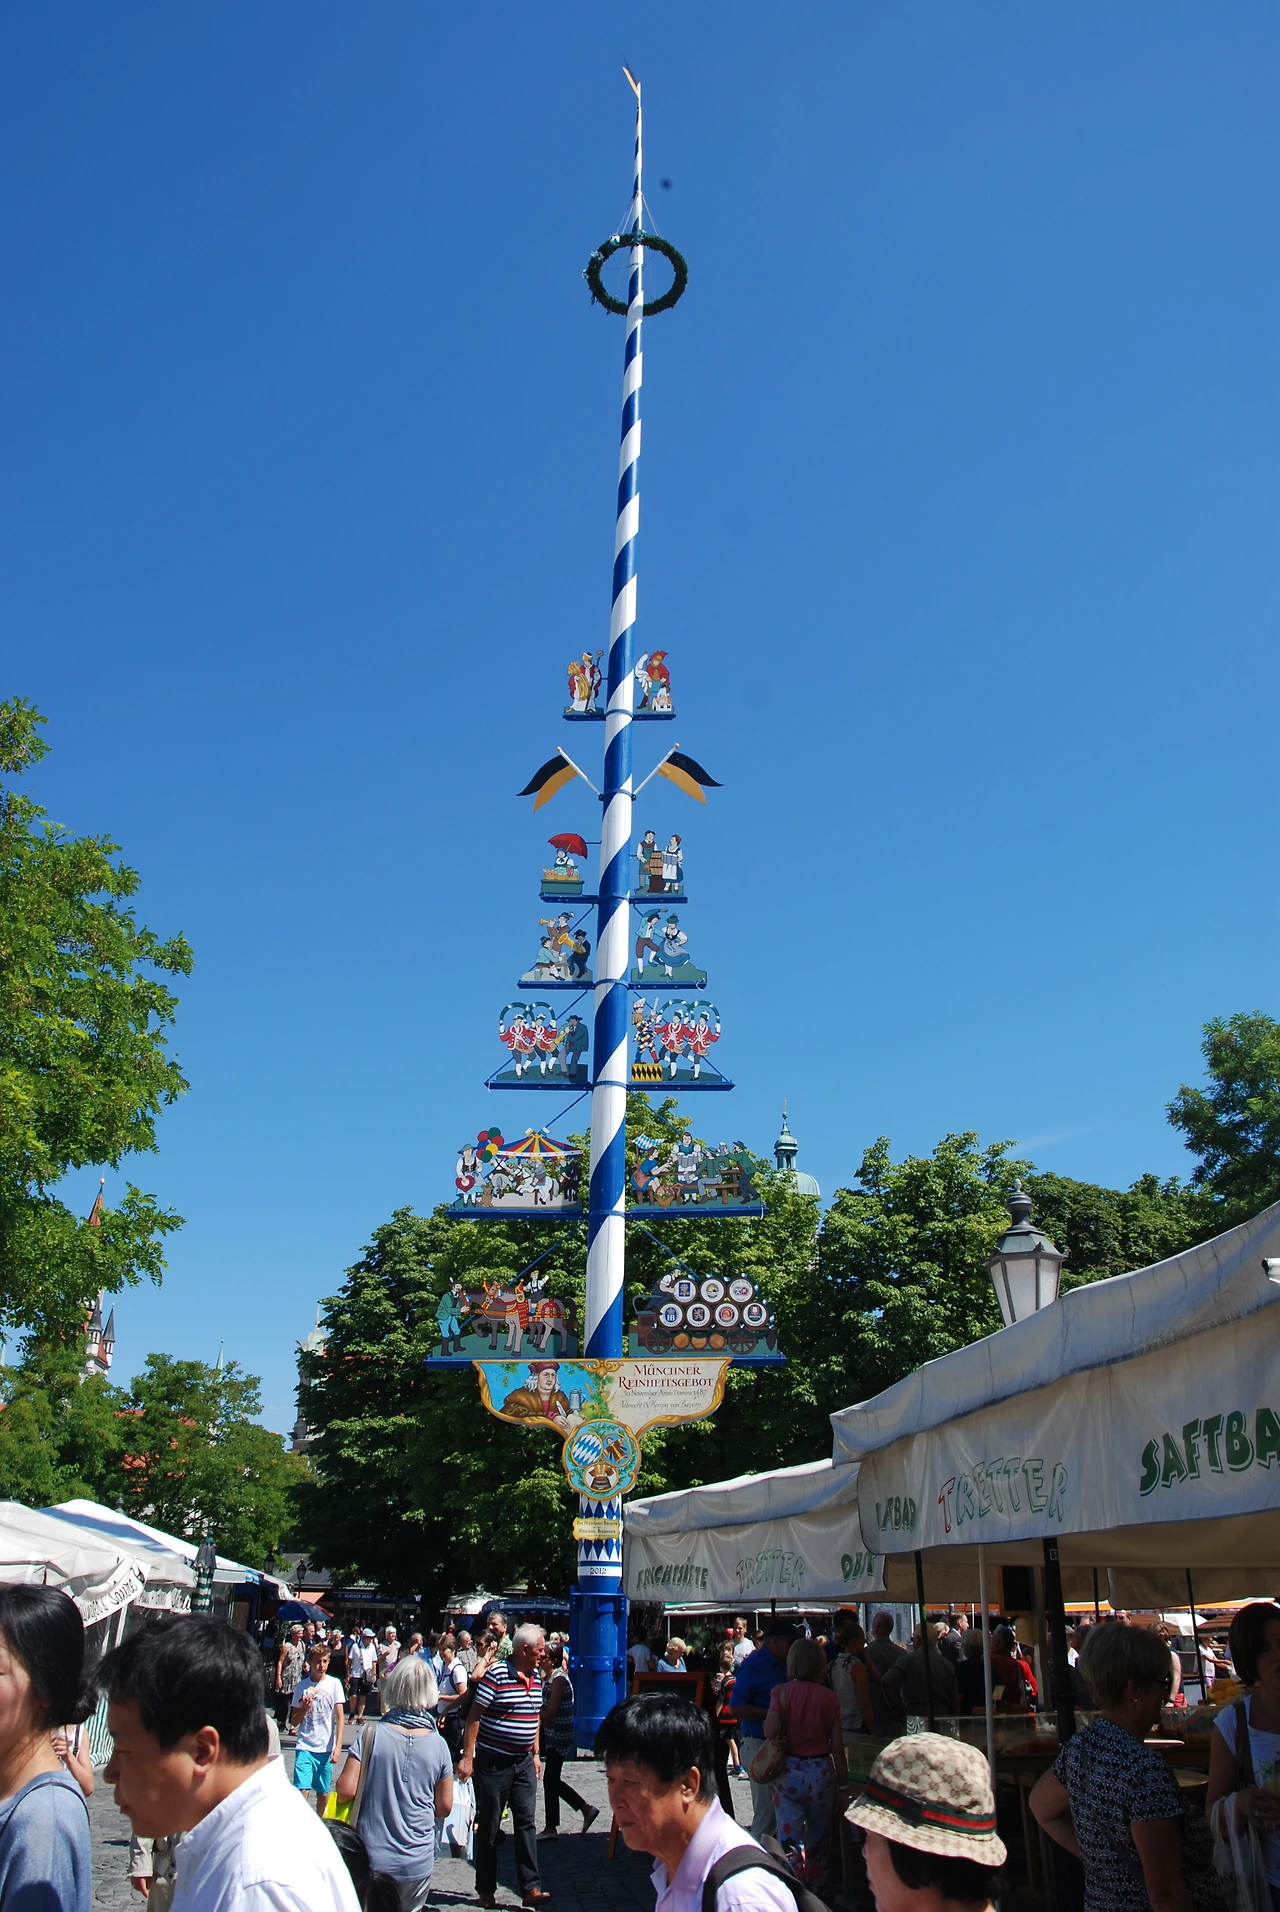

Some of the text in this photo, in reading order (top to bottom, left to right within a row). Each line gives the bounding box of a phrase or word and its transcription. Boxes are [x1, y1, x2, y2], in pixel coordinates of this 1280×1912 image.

[633, 1363, 702, 1376] MÜNCHNER
[619, 1376, 713, 1390] REINHEITSGEBOT
[693, 1389, 708, 1398] 1487
[938, 1457, 1069, 1534] TRETTER
[590, 1567, 607, 1575] 2012
[735, 1549, 807, 1594] TRETTER
